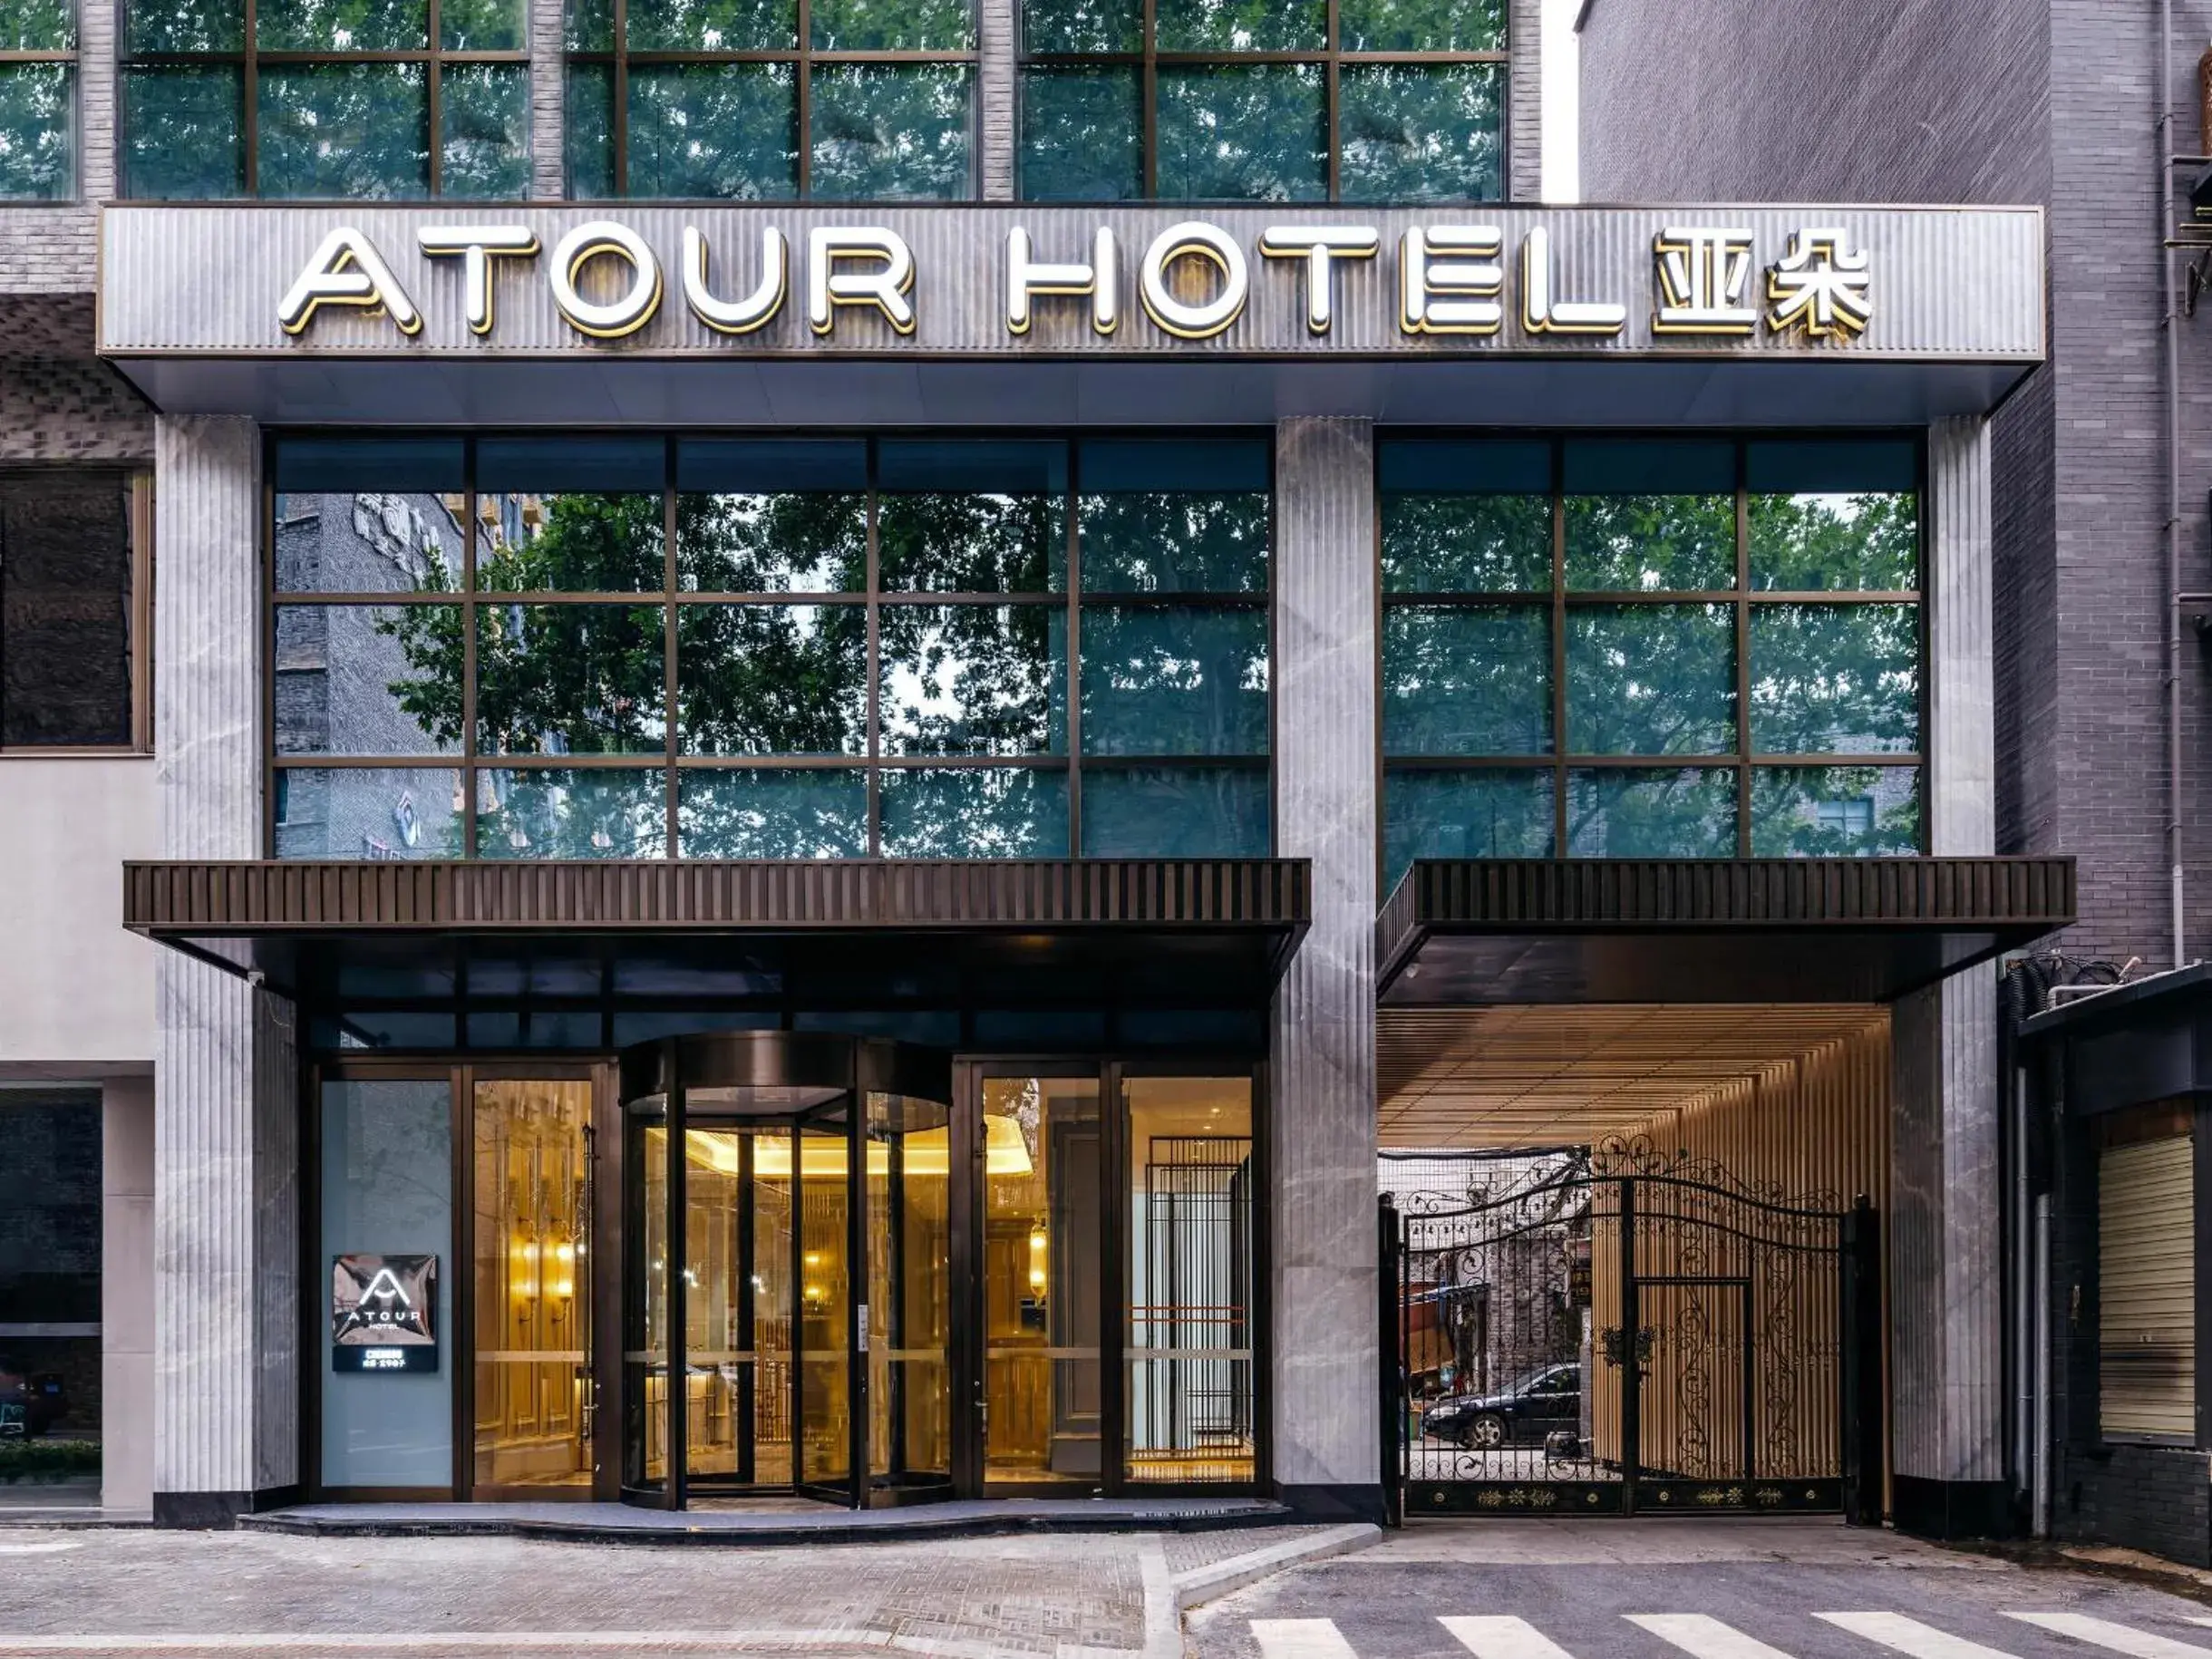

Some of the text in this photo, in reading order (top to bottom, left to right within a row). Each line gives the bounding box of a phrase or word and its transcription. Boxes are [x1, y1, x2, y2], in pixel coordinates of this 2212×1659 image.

[277, 220, 1629, 337] ATOUR HOTEL
[1654, 227, 1874, 335] 亚朵
[347, 1312, 421, 1321] ATOUR
